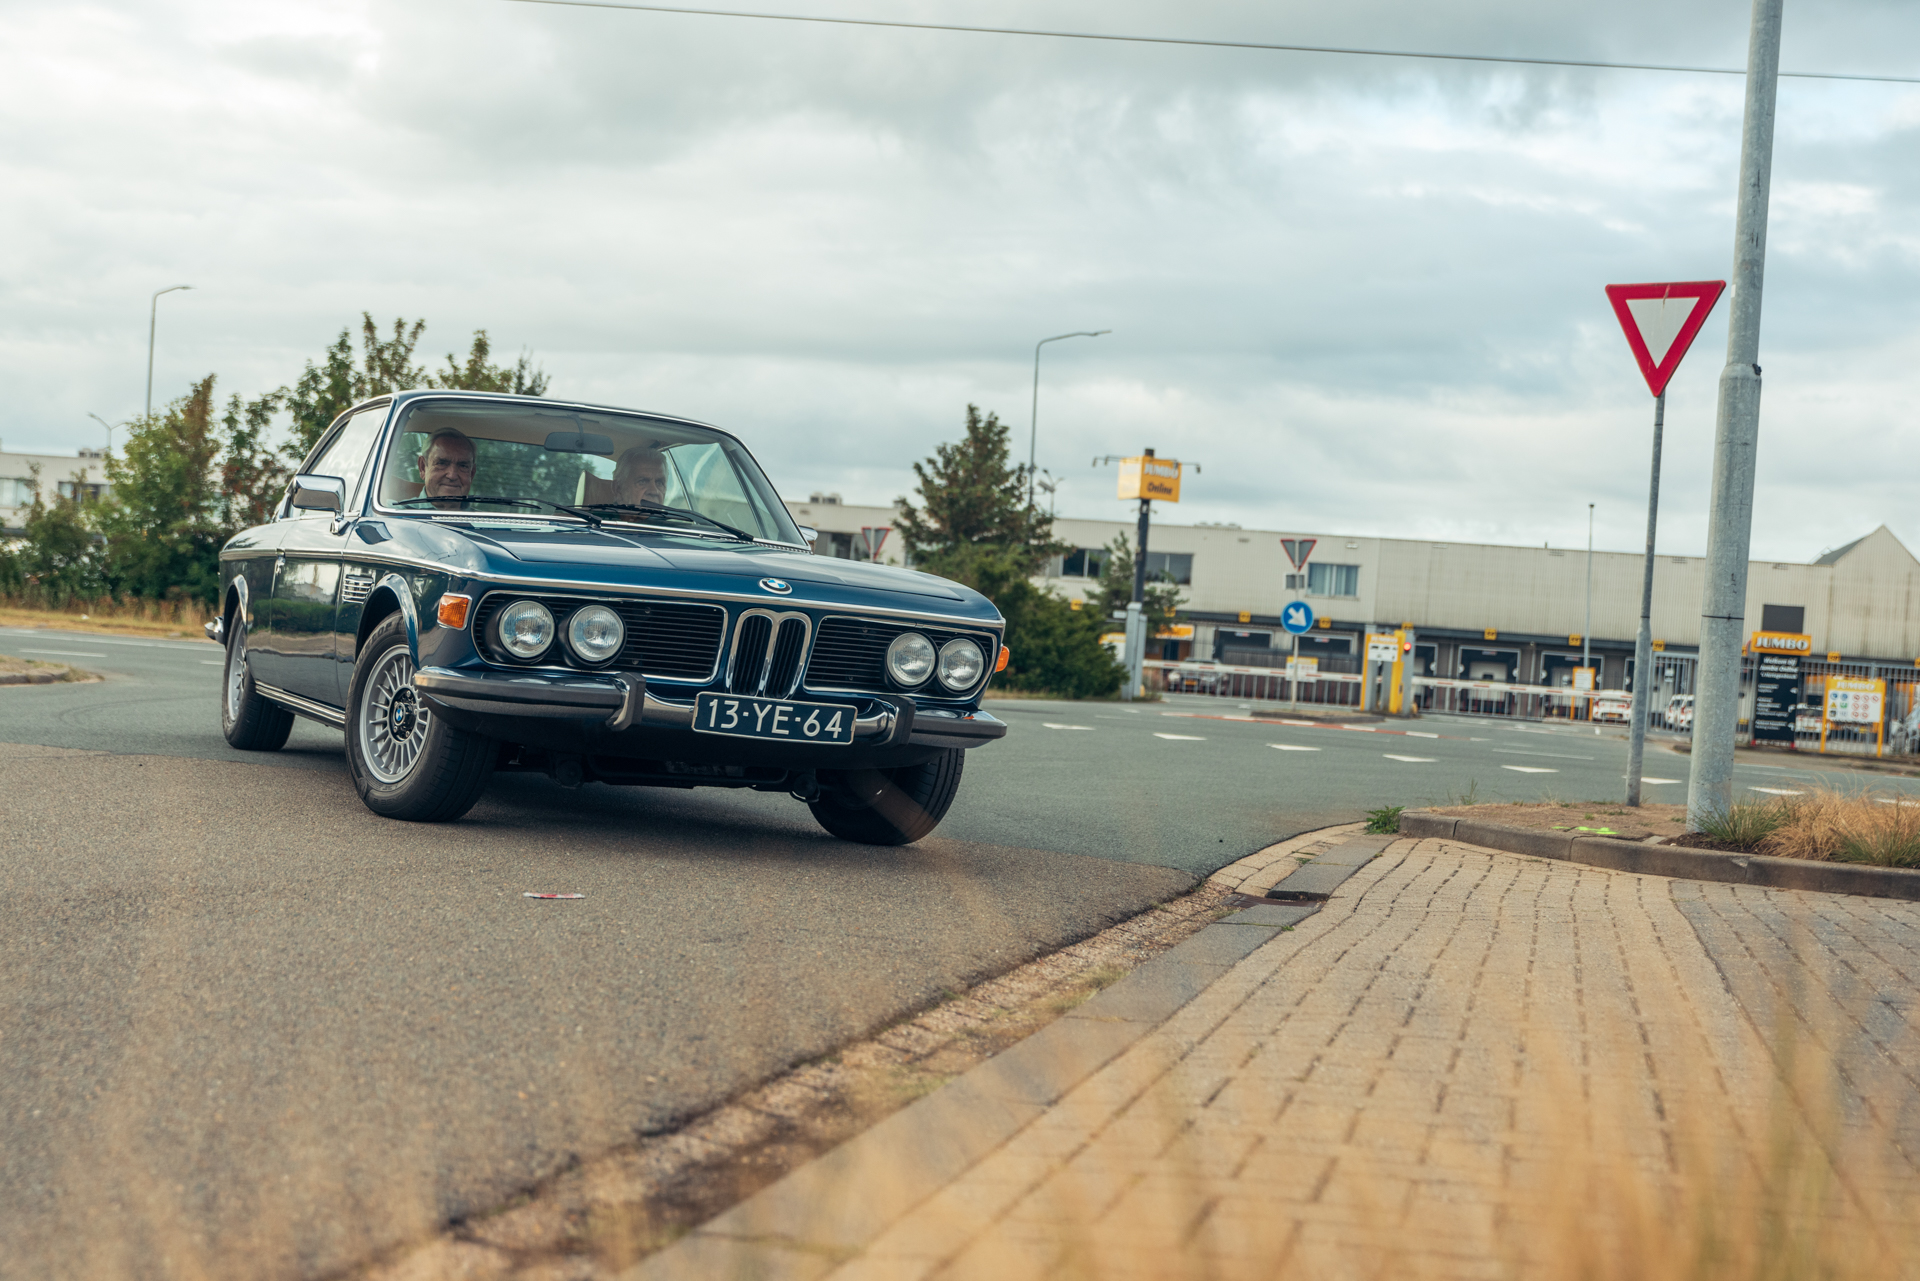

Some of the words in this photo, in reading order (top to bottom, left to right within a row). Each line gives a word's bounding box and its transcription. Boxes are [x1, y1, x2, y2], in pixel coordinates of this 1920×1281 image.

[1144, 463, 1179, 480] JUMBO
[1147, 482, 1173, 496] Online
[1755, 636, 1808, 651] JUMBO
[1836, 681, 1876, 691] JUMBO
